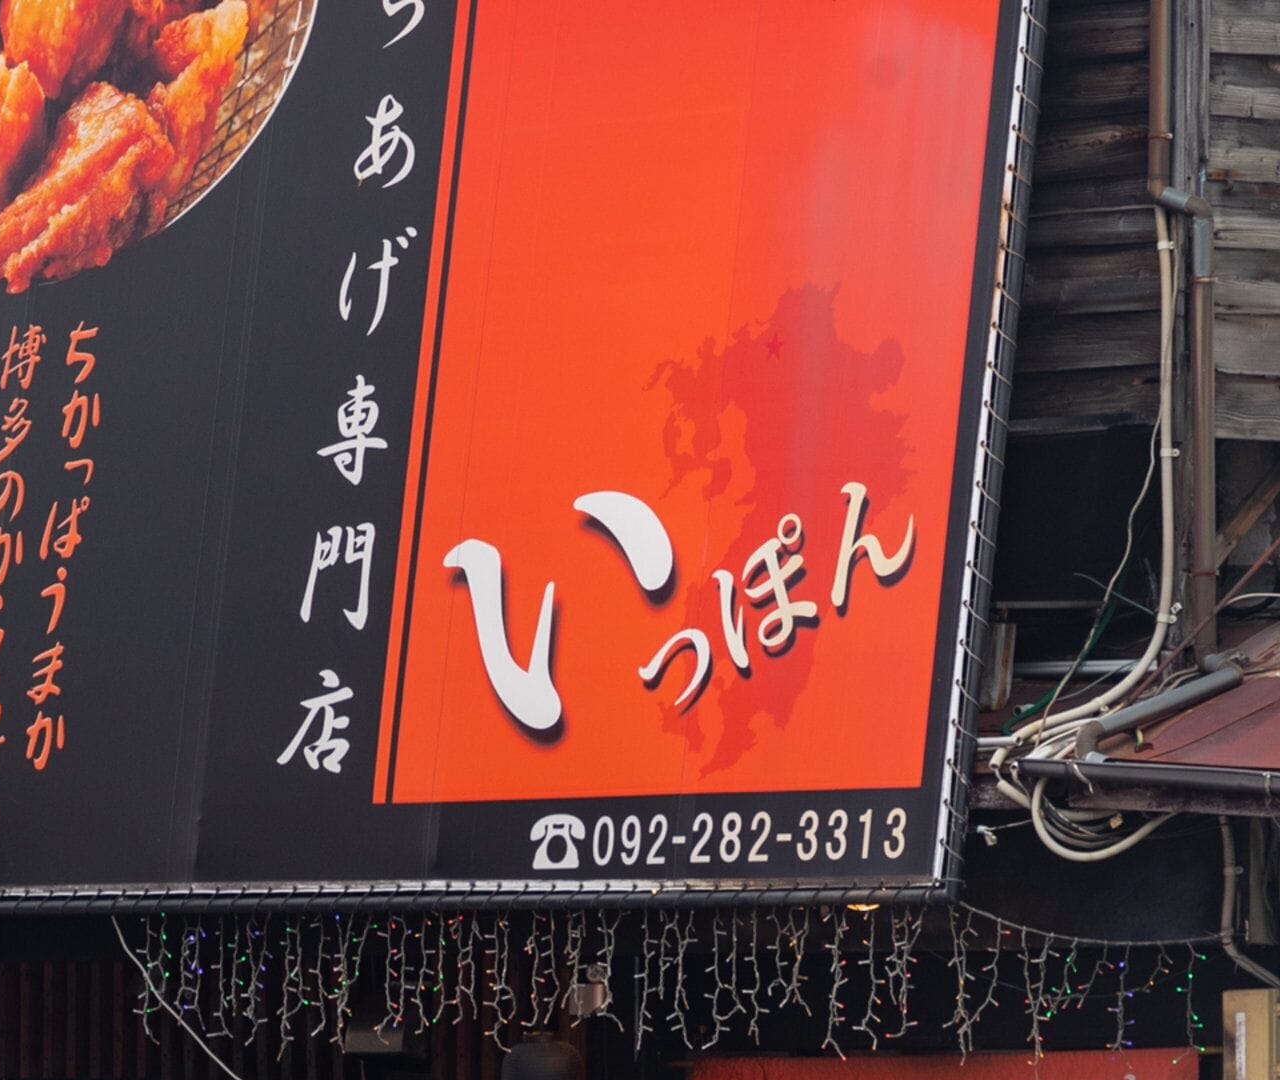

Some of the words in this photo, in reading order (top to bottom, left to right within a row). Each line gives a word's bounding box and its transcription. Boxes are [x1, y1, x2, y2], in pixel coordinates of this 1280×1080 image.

[24, 321, 103, 771] ちかっぱうまか
[443, 481, 915, 731] いっぽん
[592, 808, 908, 867] 092-282-3313
